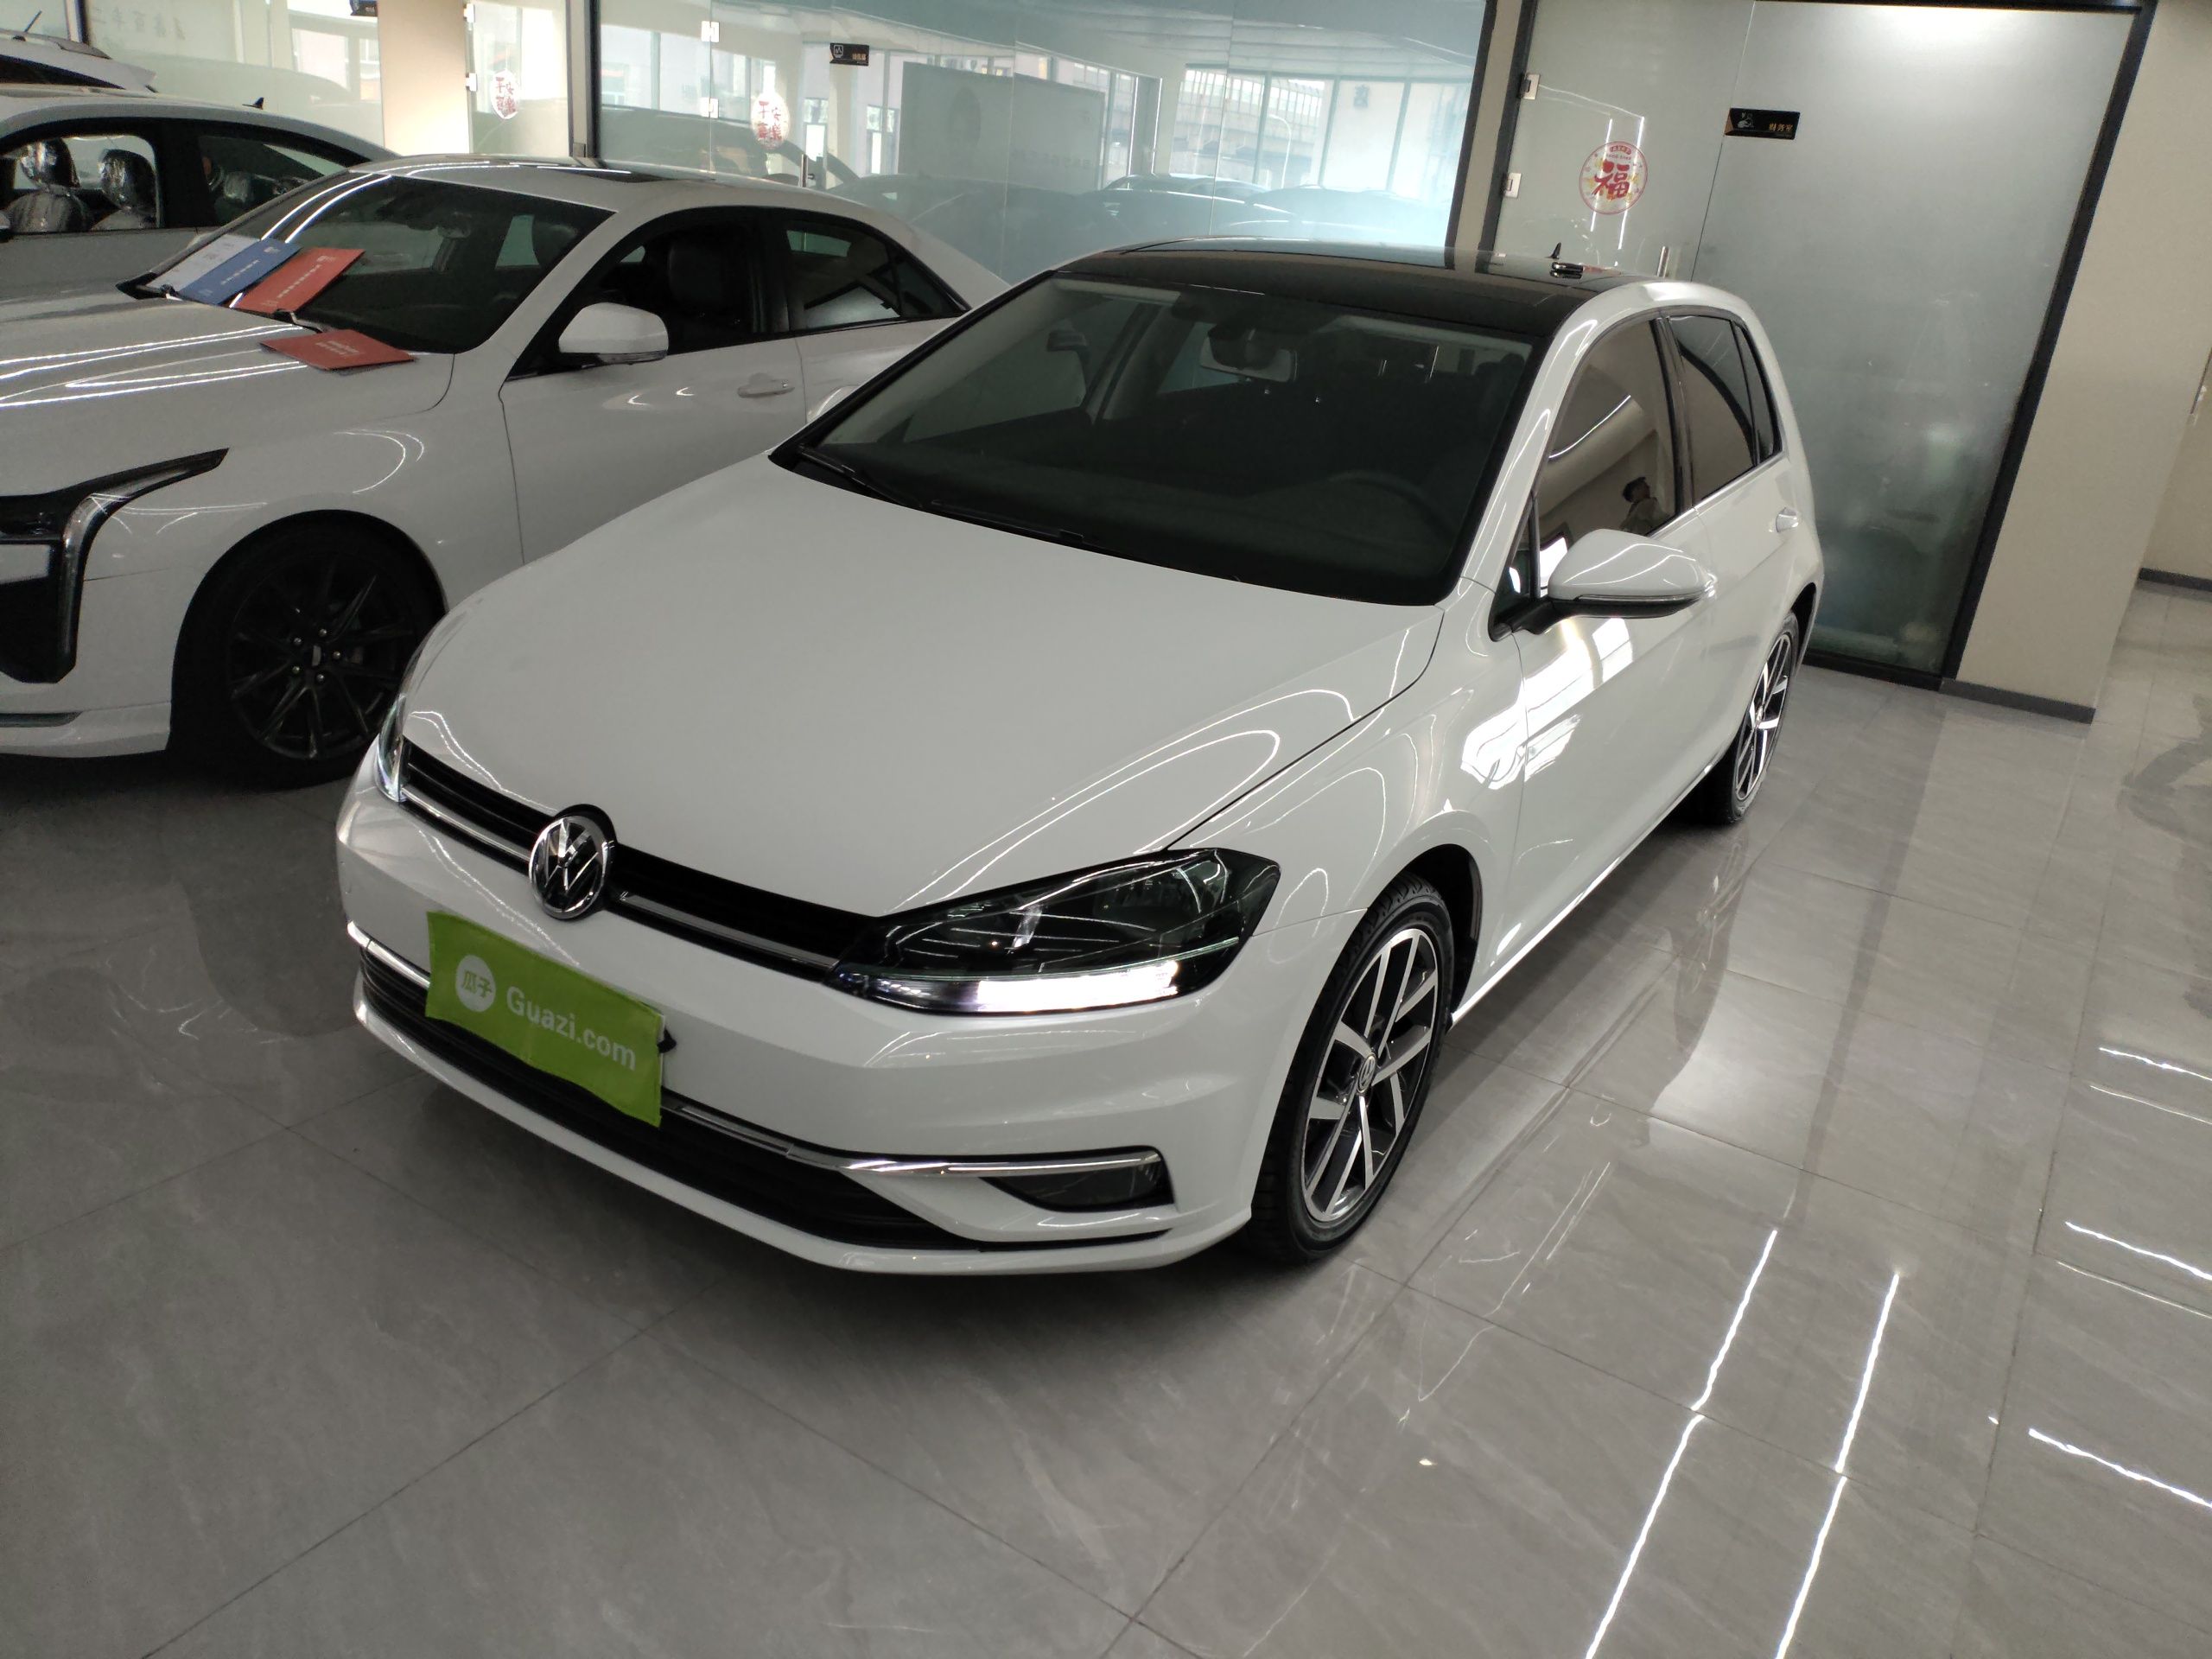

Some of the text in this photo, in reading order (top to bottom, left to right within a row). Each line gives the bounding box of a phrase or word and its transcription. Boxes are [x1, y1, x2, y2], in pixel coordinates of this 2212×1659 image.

[1592, 159, 1630, 199] 福
[461, 969, 493, 999] 瓜子
[505, 985, 637, 1071] Guazi.com
